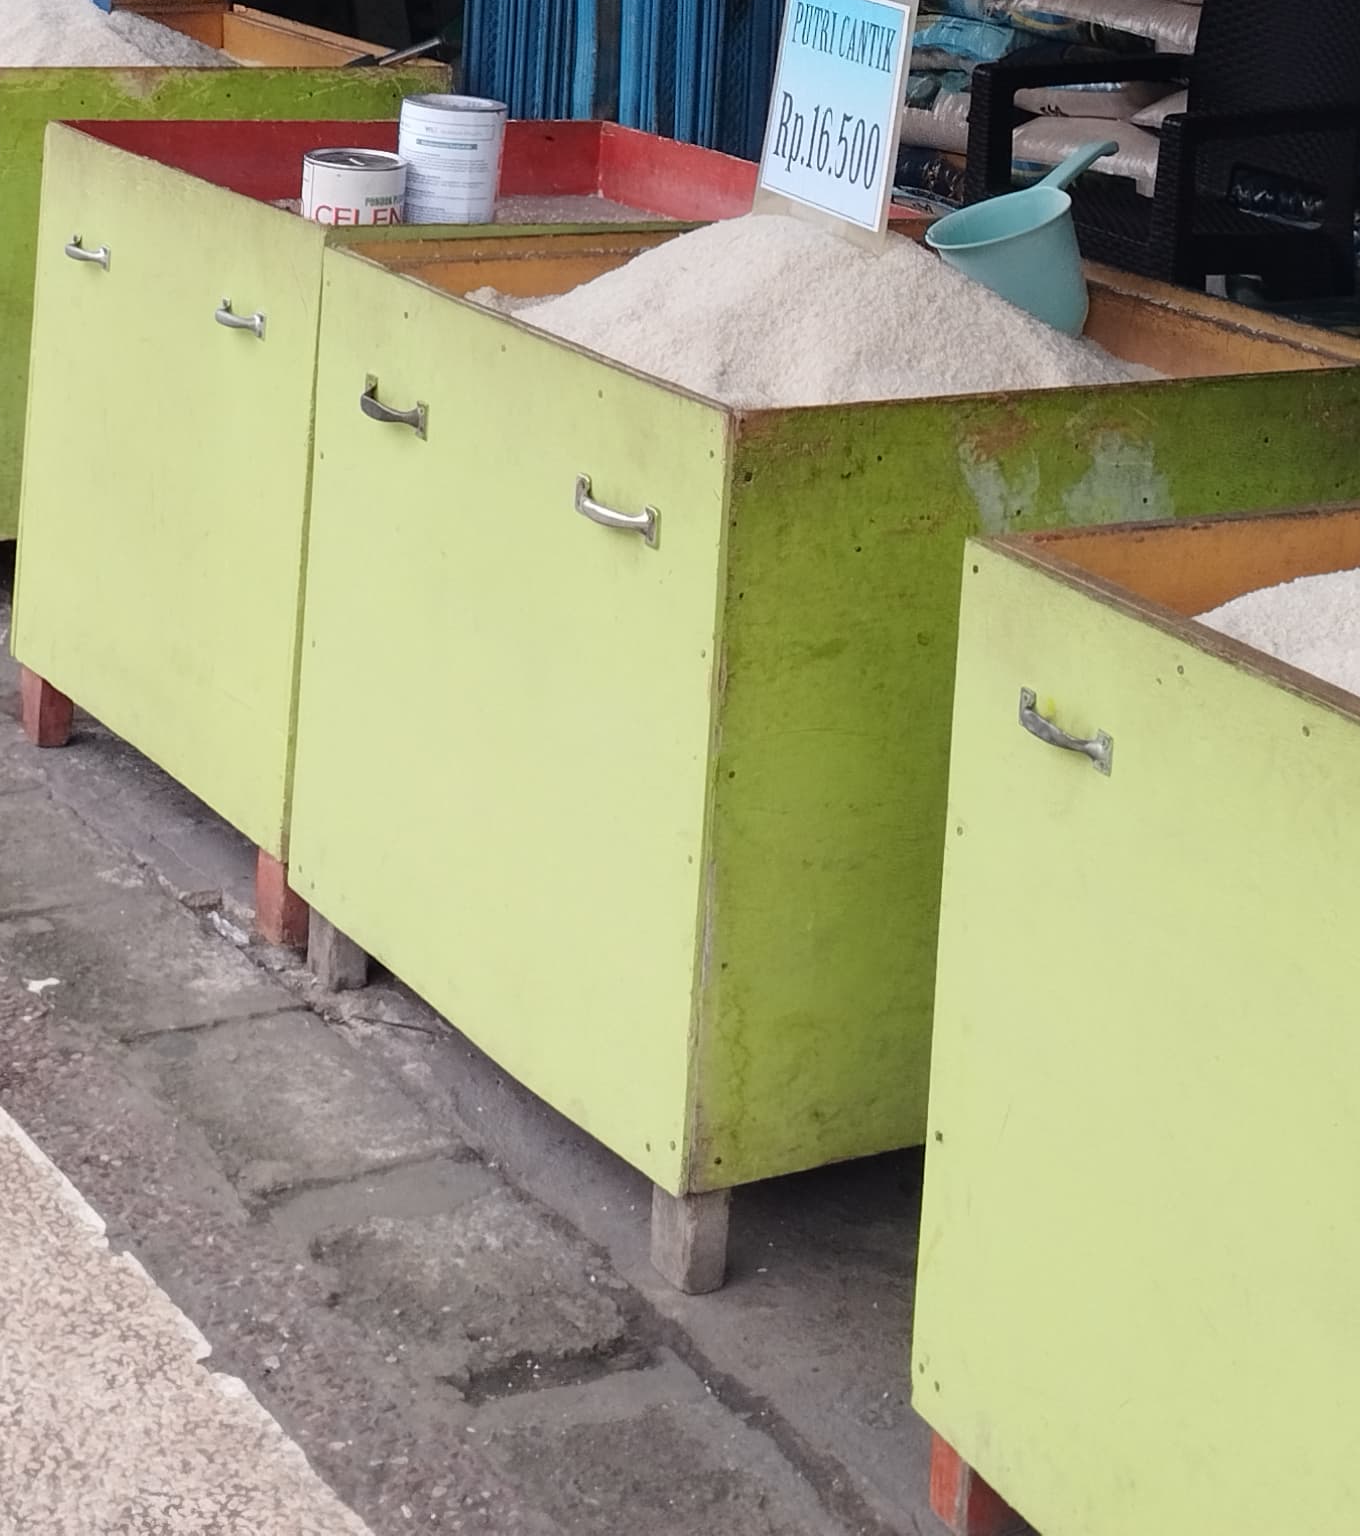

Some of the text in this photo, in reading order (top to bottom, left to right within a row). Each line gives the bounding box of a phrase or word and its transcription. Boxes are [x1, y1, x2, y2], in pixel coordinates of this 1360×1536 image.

[792, 1, 897, 73] PUTRI CANTIK
[773, 91, 880, 190] Rp.16.500
